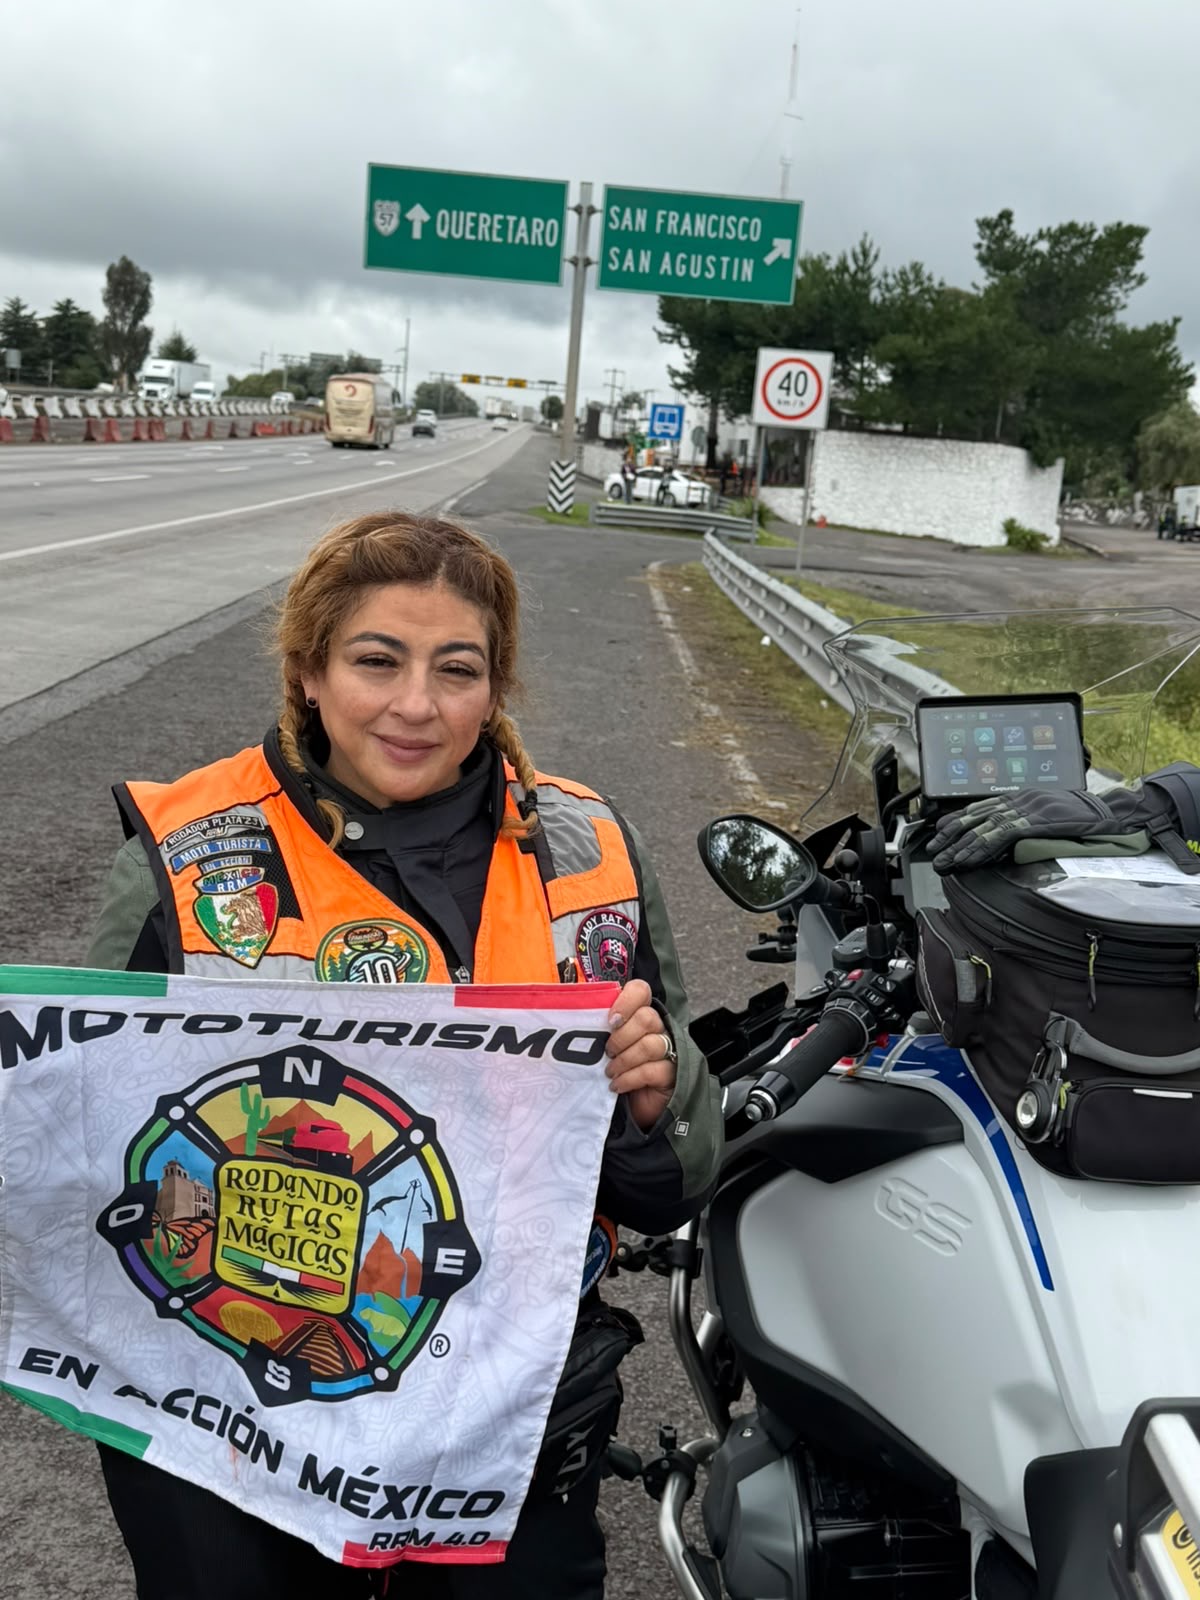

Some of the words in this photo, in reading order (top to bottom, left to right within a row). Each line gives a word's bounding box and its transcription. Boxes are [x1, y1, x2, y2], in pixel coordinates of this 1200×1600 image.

[379, 212, 394, 226] 57
[435, 209, 559, 247] QUERETARO
[608, 205, 647, 232] SAN
[655, 210, 762, 242] FRANCISCO
[608, 246, 651, 274] SAN
[659, 251, 754, 283] AGUSTIN
[778, 370, 808, 397] 40
[168, 820, 210, 845] RODADOR
[180, 844, 210, 864] MOTO
[216, 839, 261, 851] TURISTA
[203, 867, 261, 886] MEXICO
[217, 879, 248, 893] RRM
[580, 915, 598, 941] LADY
[601, 913, 623, 924] RAT
[0, 1006, 611, 1070] MOTOTURISMO
[283, 1056, 322, 1086] N
[108, 1203, 145, 1229] O
[874, 1176, 973, 1257] GS
[433, 1247, 467, 1276] E
[264, 1358, 292, 1392] S
[18, 1347, 100, 1391] EN
[113, 1384, 285, 1474] ACCIÓN
[298, 1453, 506, 1520] MÉXICO
[368, 1527, 436, 1551] RRM
[442, 1531, 491, 1546] 4.0
